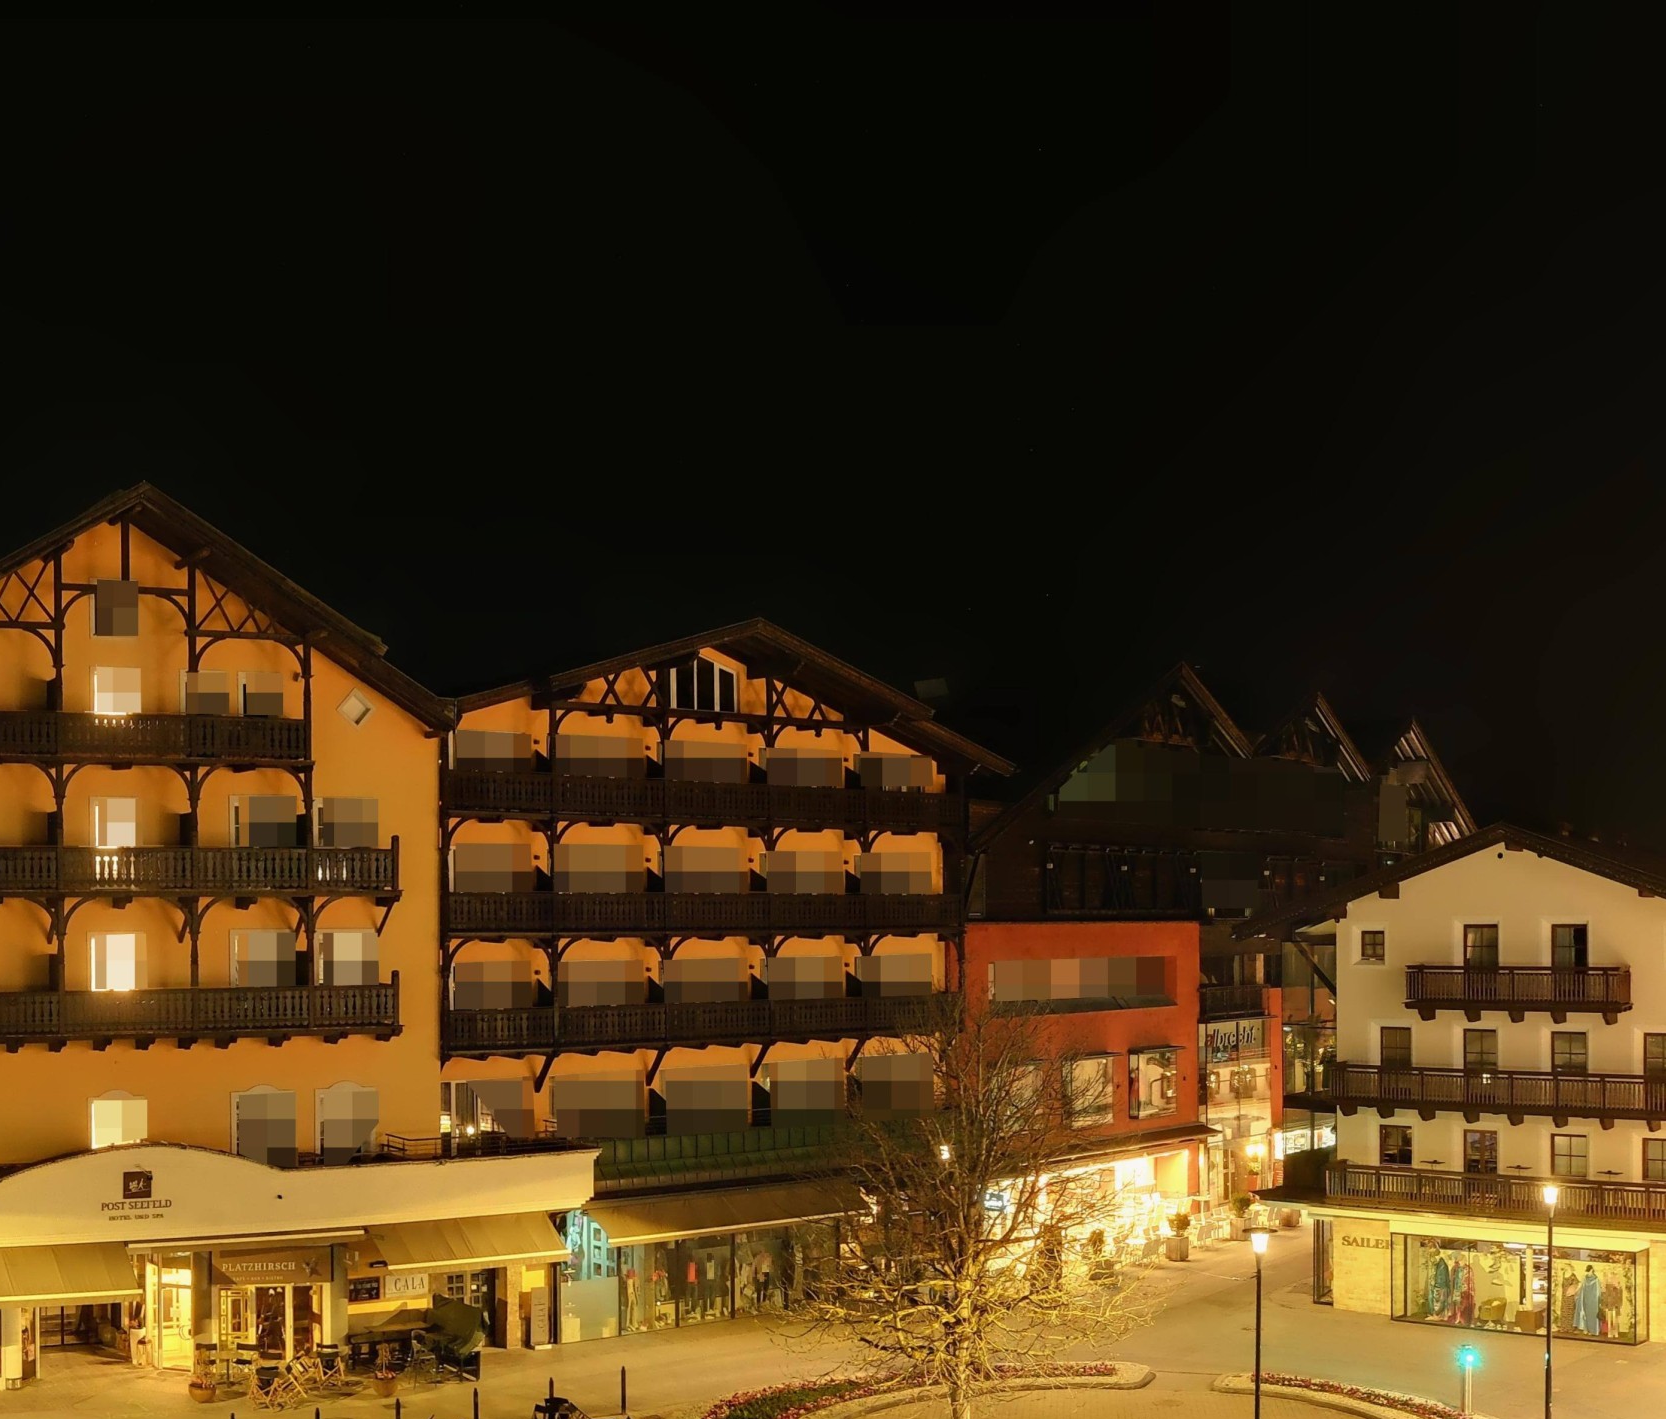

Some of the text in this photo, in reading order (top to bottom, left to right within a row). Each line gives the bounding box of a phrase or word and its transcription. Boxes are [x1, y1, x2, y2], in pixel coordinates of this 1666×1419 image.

[101, 1199, 172, 1211] POST SEEFELD
[222, 1262, 296, 1272] PLATZHIRSCH
[394, 1276, 425, 1292] CALA
